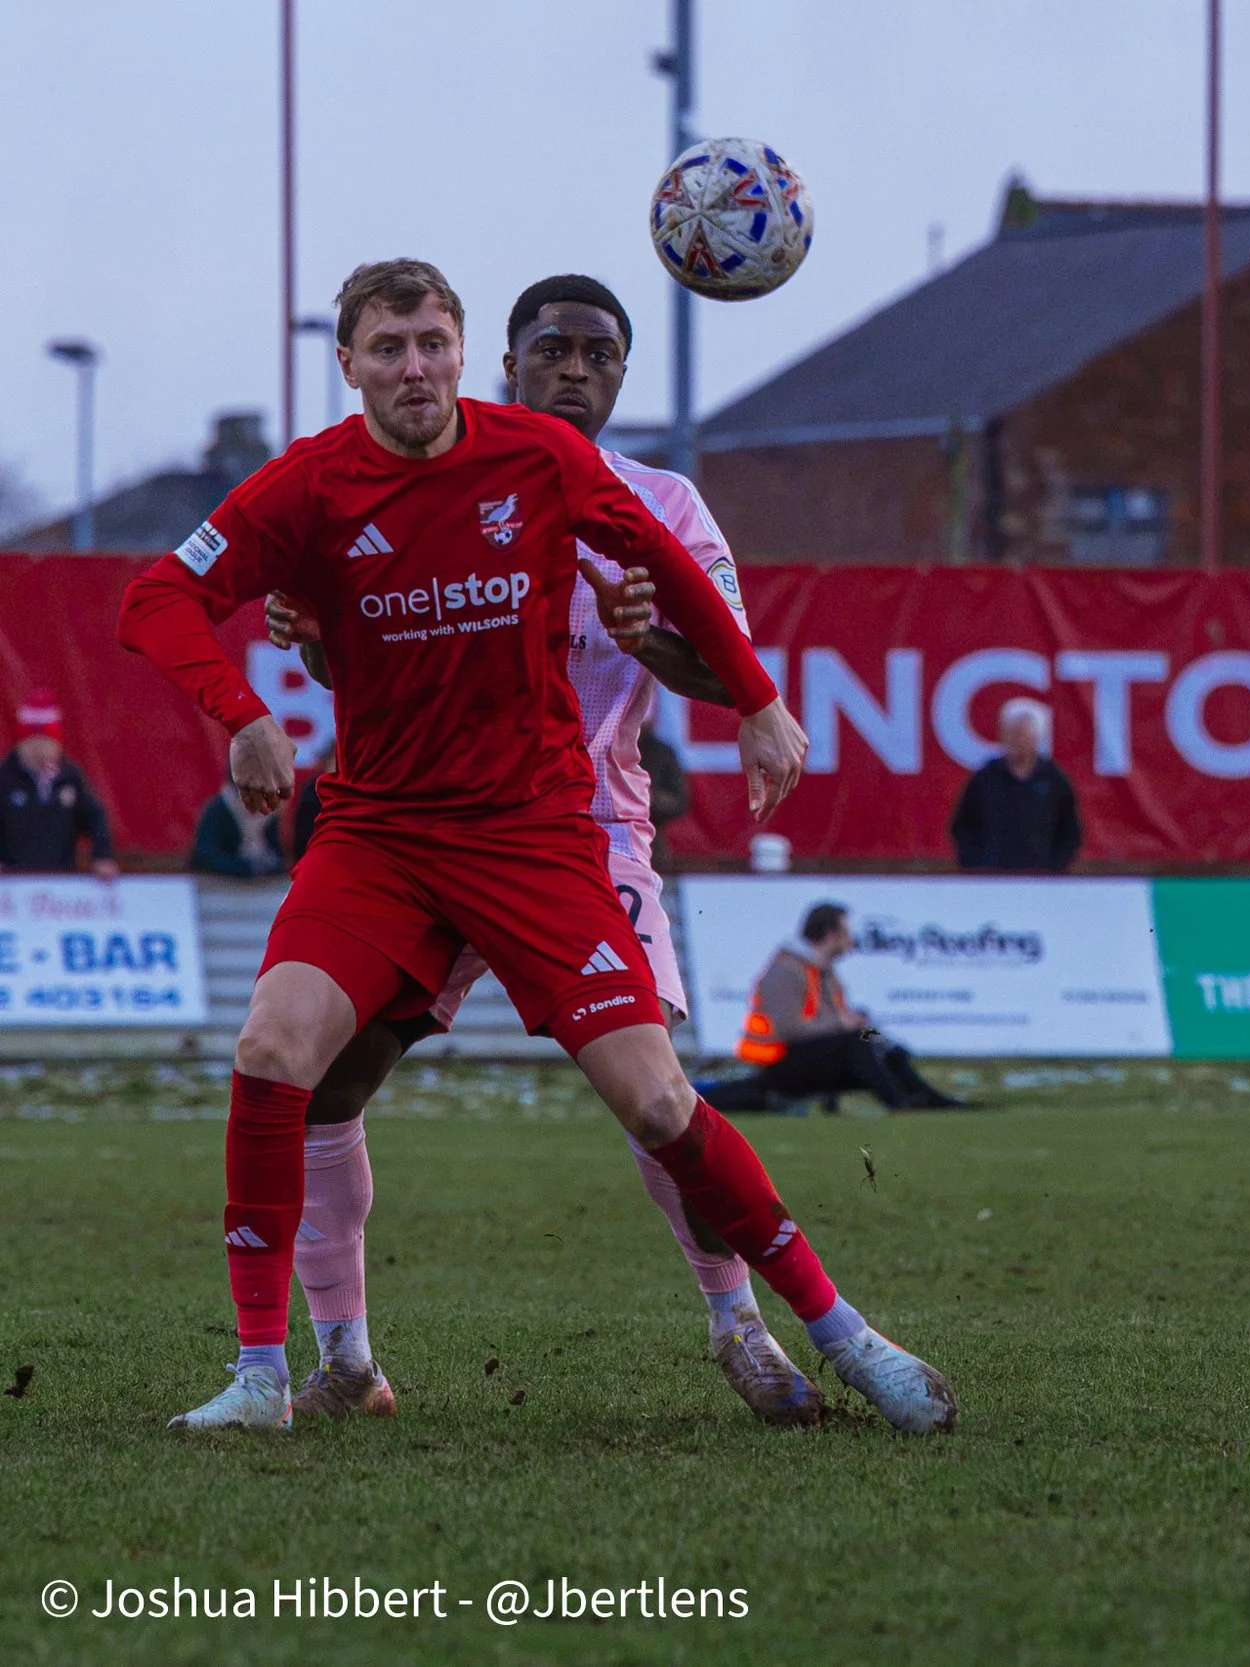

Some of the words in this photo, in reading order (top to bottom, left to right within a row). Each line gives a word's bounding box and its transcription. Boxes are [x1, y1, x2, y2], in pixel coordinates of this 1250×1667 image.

[382, 629, 427, 643] working
[429, 624, 455, 637] with
[457, 614, 519, 634] WILSONS
[59, 929, 179, 976] BAR
[589, 995, 637, 1014] Sondico
